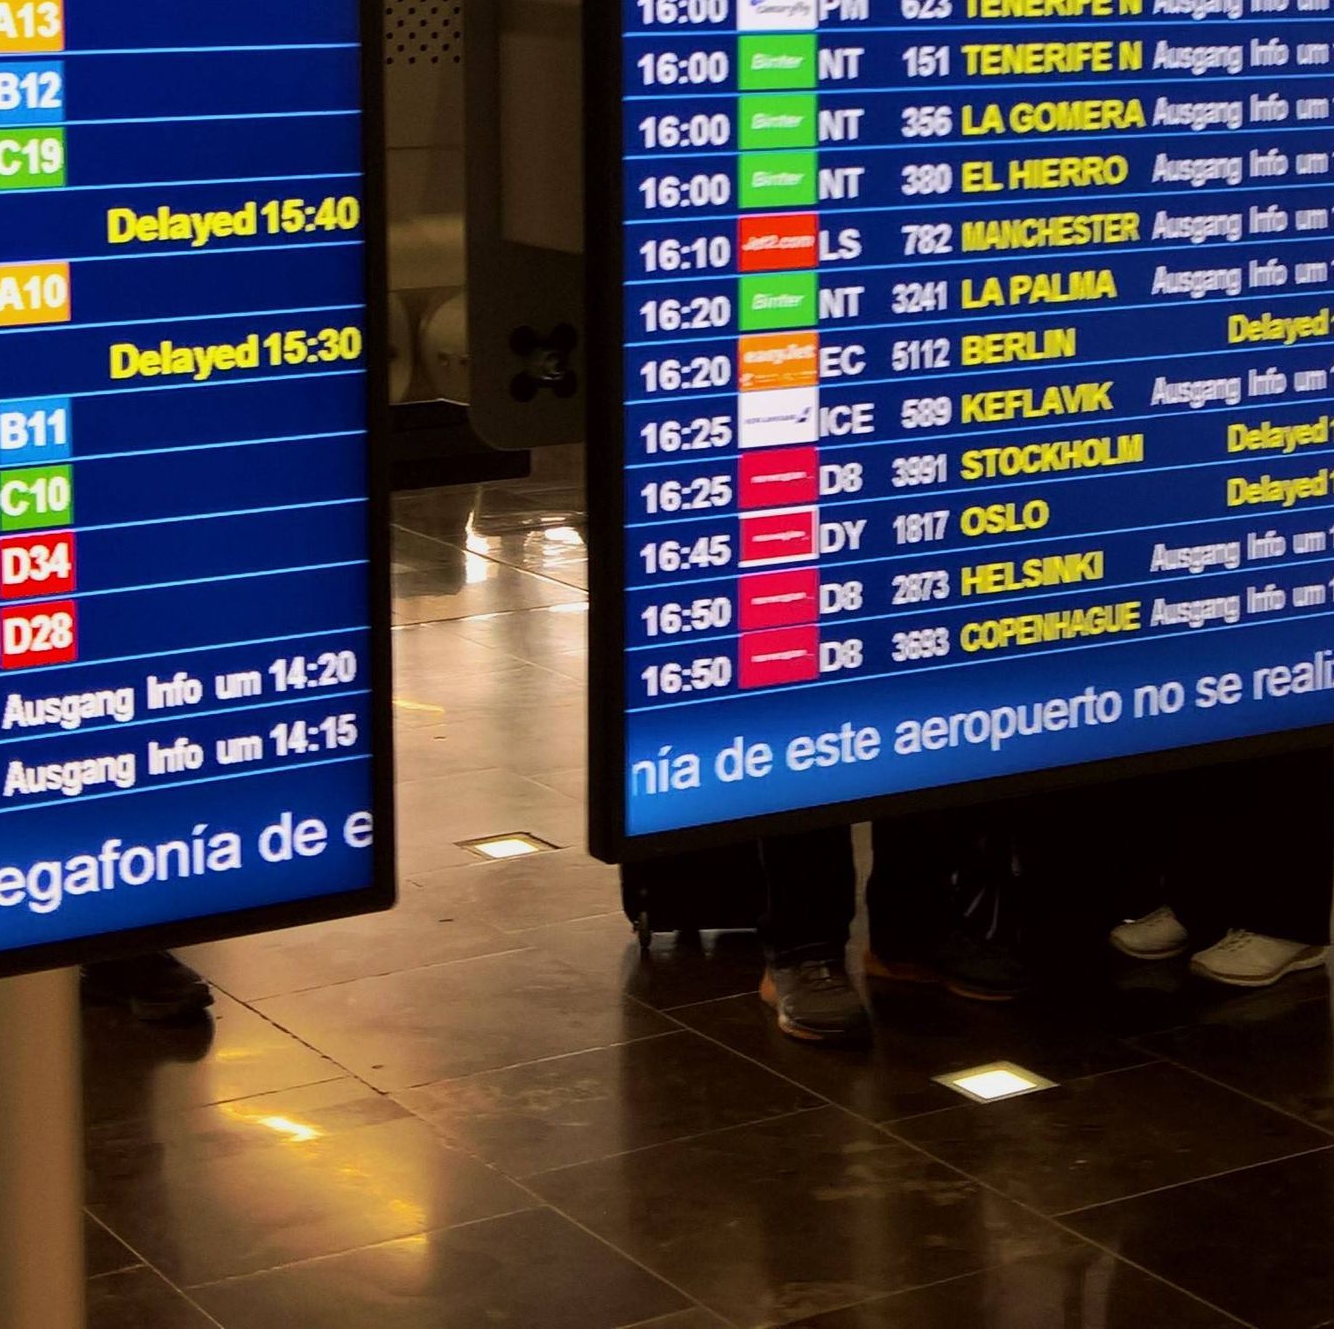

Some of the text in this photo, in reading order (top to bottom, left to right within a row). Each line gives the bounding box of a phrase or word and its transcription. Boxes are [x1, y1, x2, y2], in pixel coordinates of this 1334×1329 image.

[106, 200, 258, 248] Delayed
[259, 195, 360, 235] 15:40
[639, 354, 732, 393] 16:20
[819, 343, 867, 379] EC
[891, 337, 951, 372] 5112
[960, 327, 1077, 367] BERLIN
[1227, 307, 1330, 346] Delayed
[2, 611, 74, 656] D28
[714, 735, 774, 783] de
[785, 721, 881, 772] este
[893, 686, 1123, 756] aeropuerto
[1133, 680, 1186, 719] no
[1195, 672, 1243, 709] se
[257, 811, 329, 863] de
